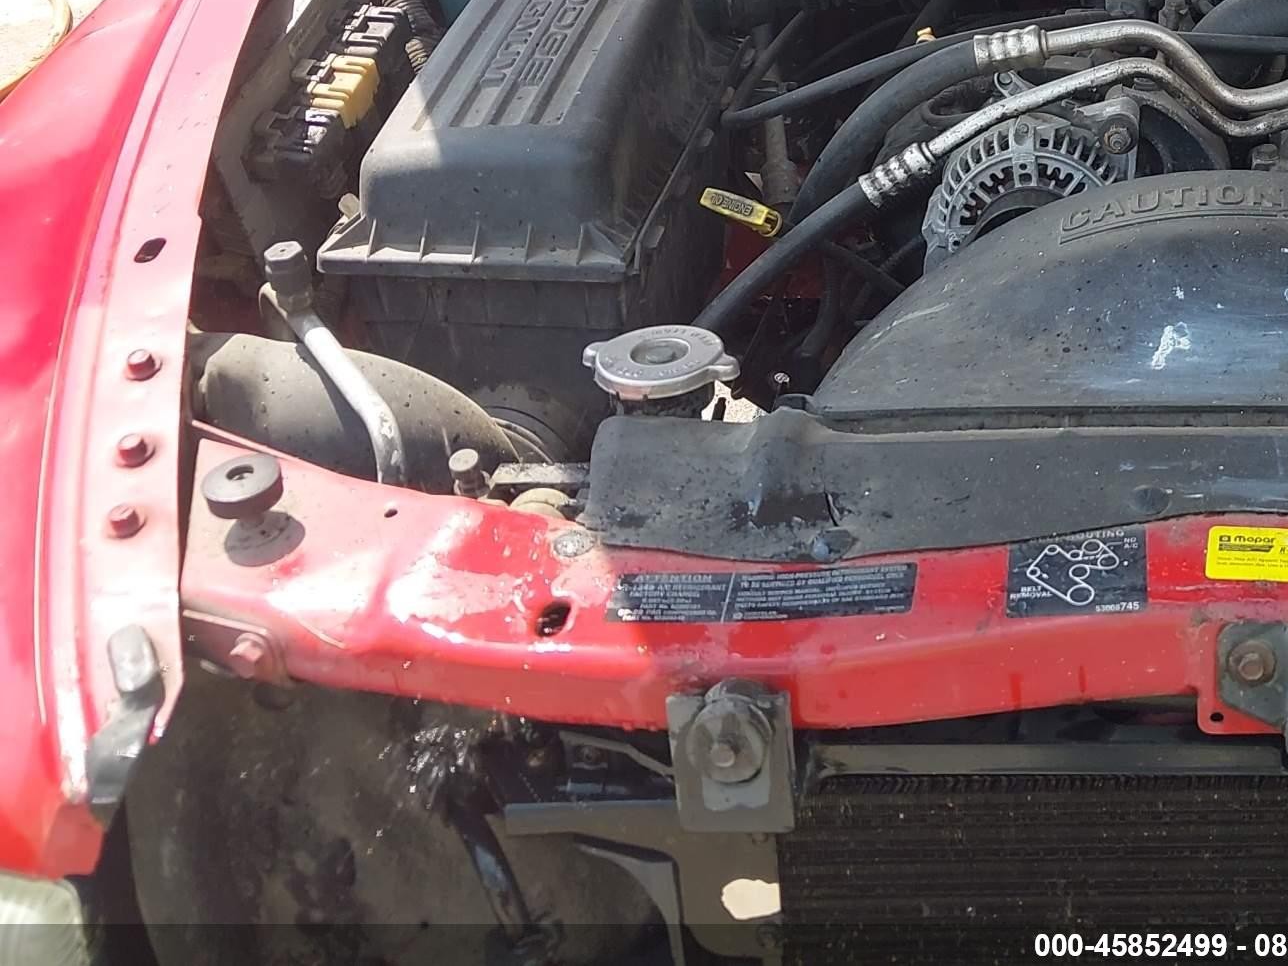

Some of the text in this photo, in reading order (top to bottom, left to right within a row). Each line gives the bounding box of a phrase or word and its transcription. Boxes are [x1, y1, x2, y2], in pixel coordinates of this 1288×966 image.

[722, 195, 753, 216] ENGINE
[1062, 185, 1283, 231] CAUTION
[632, 575, 712, 583] ATTENTION
